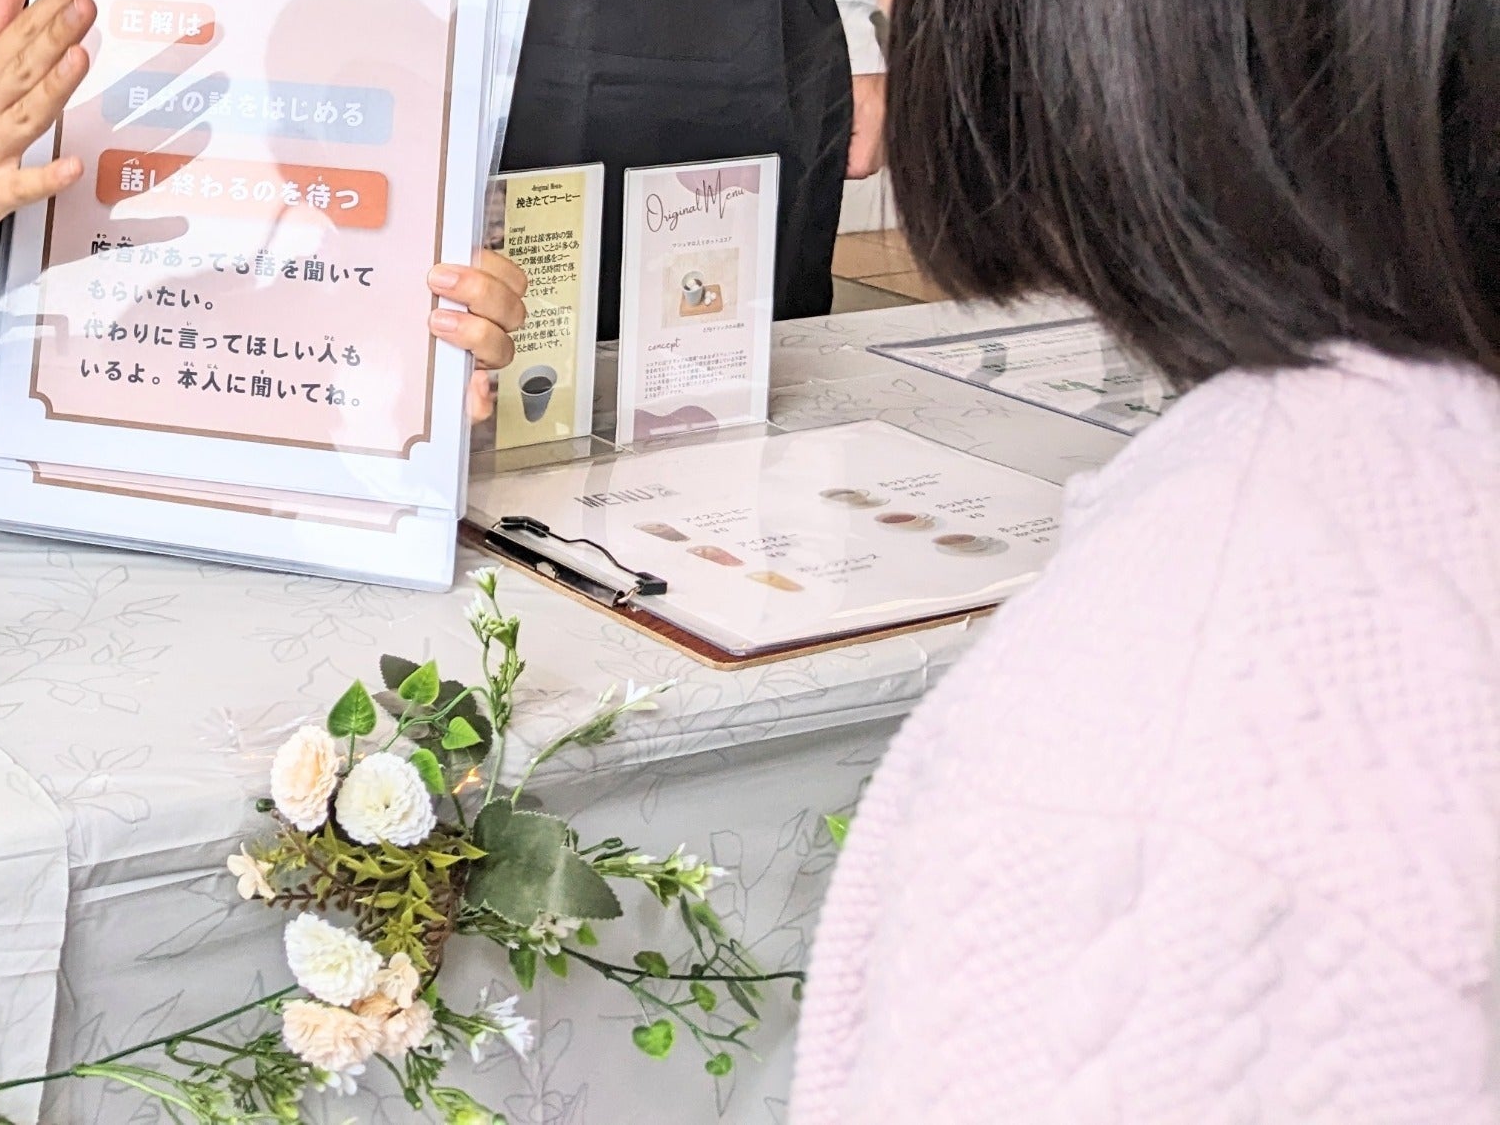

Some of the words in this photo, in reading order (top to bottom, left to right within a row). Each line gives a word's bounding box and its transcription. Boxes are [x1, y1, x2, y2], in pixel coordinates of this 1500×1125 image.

[120, 9, 202, 36] 正解は
[128, 85, 365, 127] 自分の話をはじめる
[120, 167, 360, 209] 話し終わるのを待つ
[516, 193, 581, 209] 挽きたてコーヒー
[646, 188, 702, 233] Original
[703, 170, 745, 220] Menu
[91, 240, 375, 287] 吃音があっても話を聞いて
[523, 262, 575, 275] 入れる時間で落
[87, 280, 214, 310] もらいたい。
[83, 318, 361, 367] 代わりに言ってほしい人も
[647, 337, 681, 352] concept
[80, 359, 360, 407] いるよ。本人に聞いてね。
[574, 488, 655, 508] MENU
[681, 507, 753, 523] アイスコーヒー
